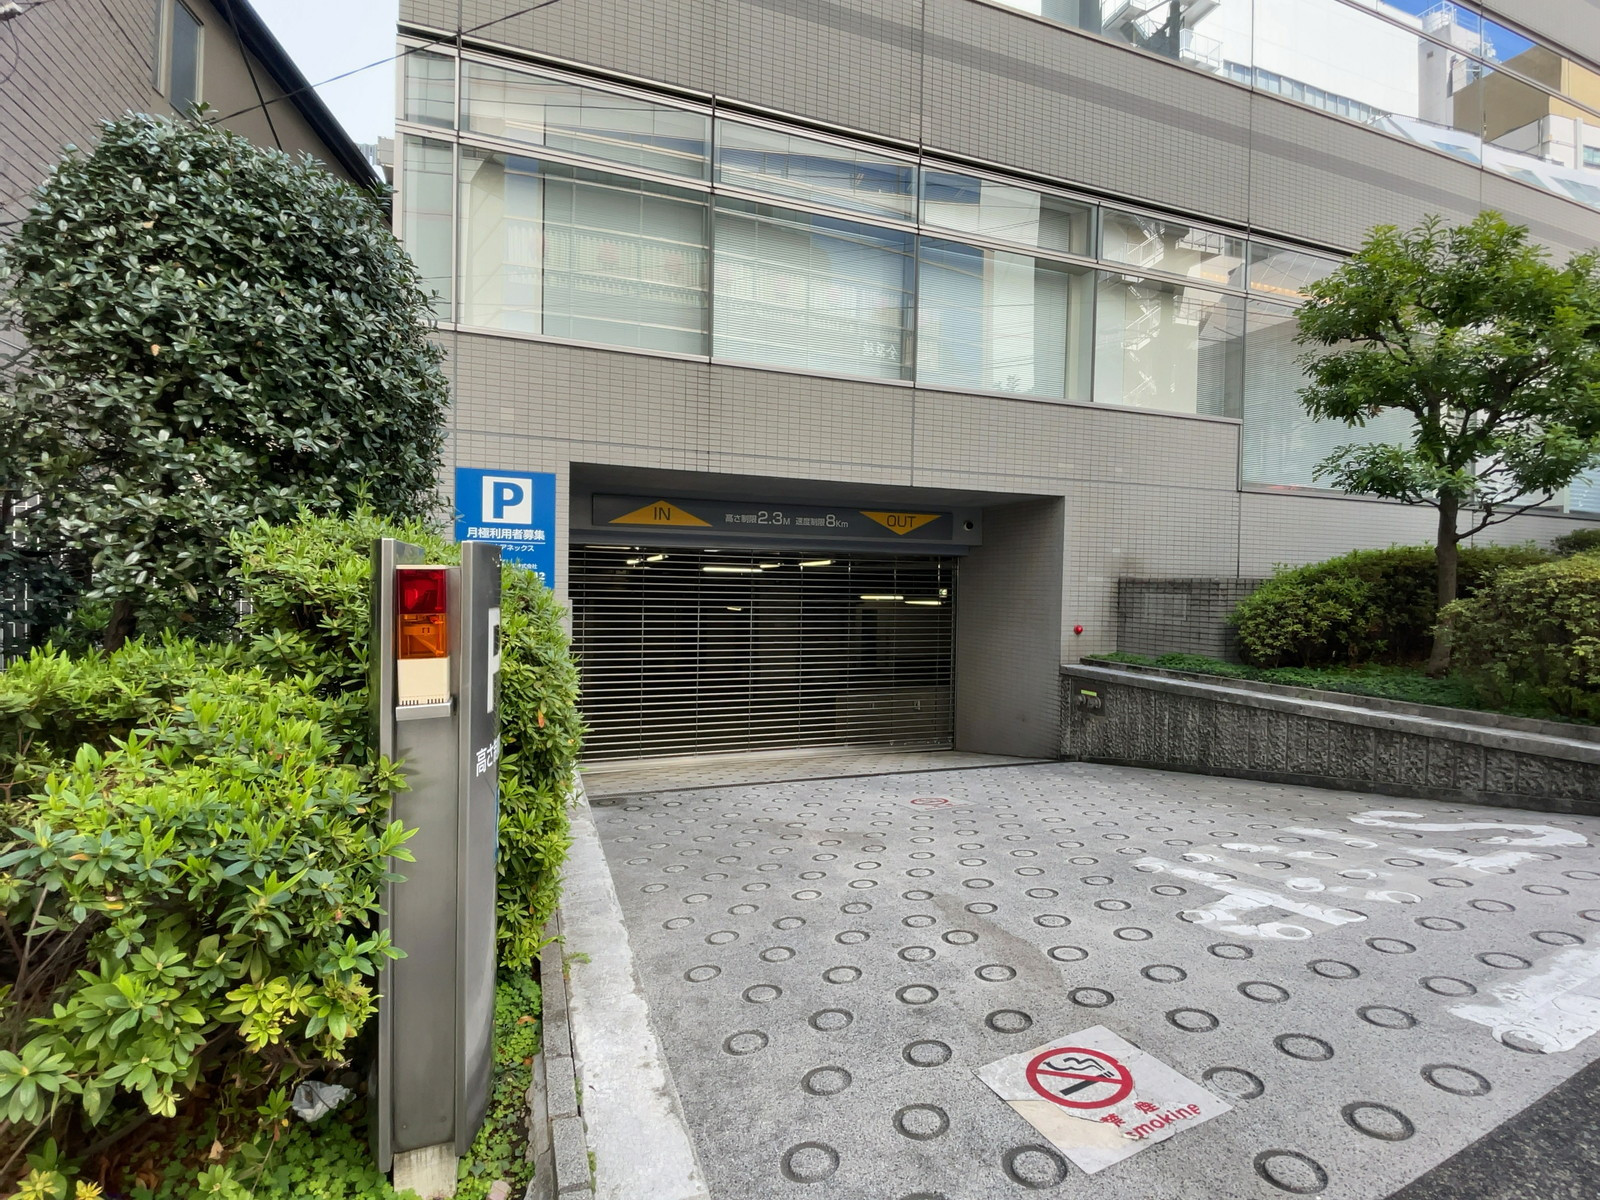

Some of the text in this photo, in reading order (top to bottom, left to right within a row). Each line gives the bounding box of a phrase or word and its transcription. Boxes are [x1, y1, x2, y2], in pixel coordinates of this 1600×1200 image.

[493, 481, 524, 519] P
[653, 506, 671, 521] IN
[886, 514, 916, 528] OUT
[466, 526, 546, 540] 月極利用者募集
[496, 544, 535, 552] アネックス
